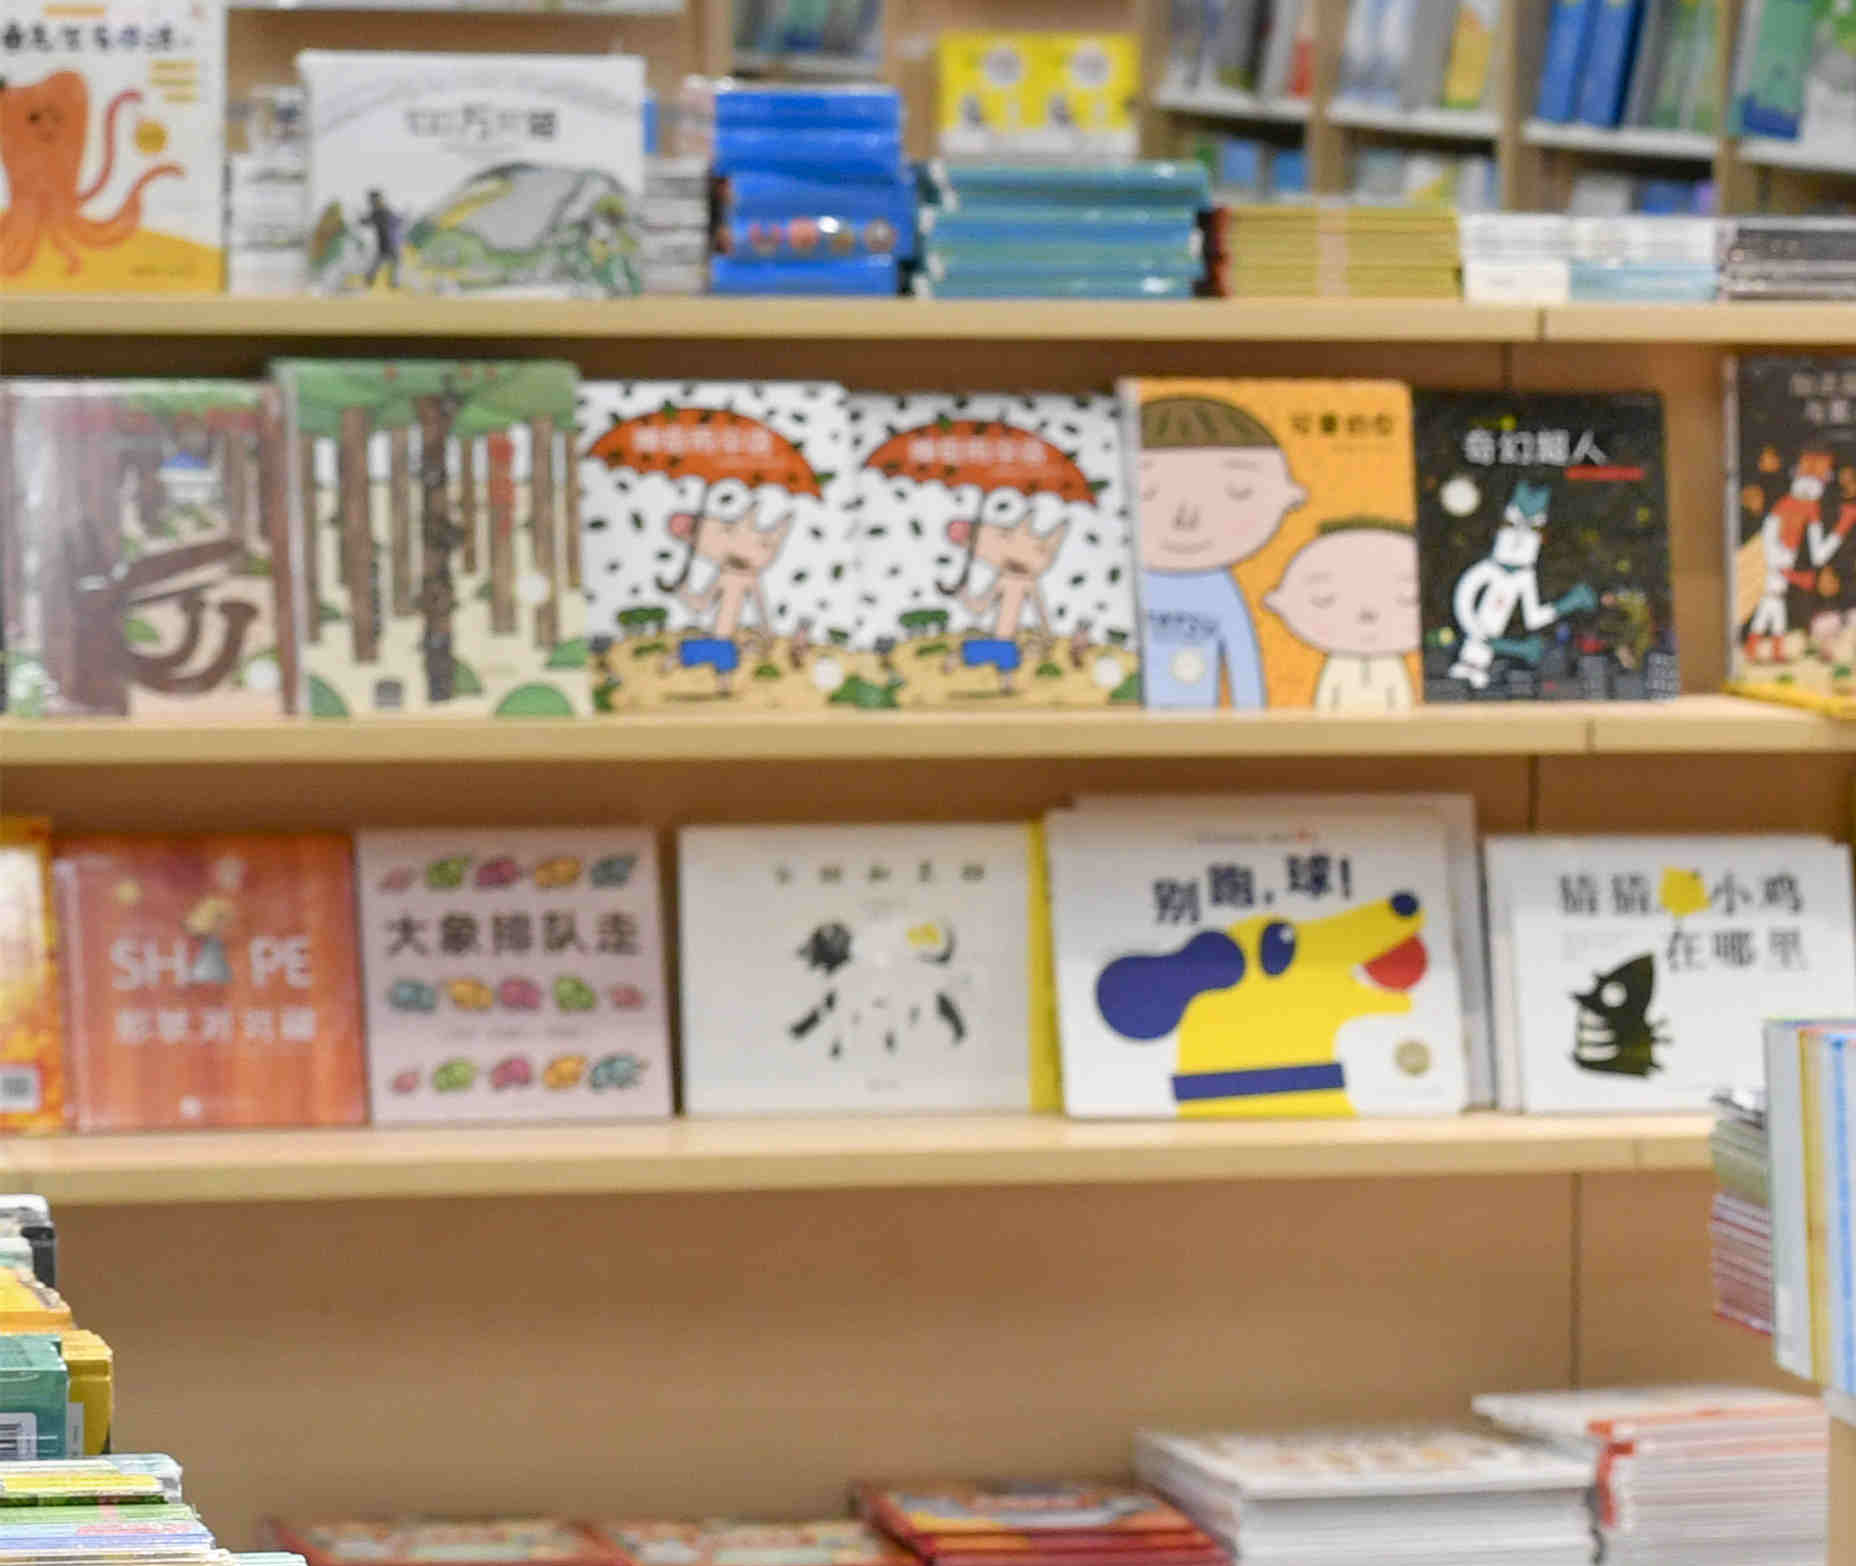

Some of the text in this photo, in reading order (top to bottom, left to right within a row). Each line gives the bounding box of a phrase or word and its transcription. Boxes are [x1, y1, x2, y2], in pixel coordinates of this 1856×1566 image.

[384, 910, 641, 957] 大象排队走
[1664, 929, 1808, 973] 在哪里
